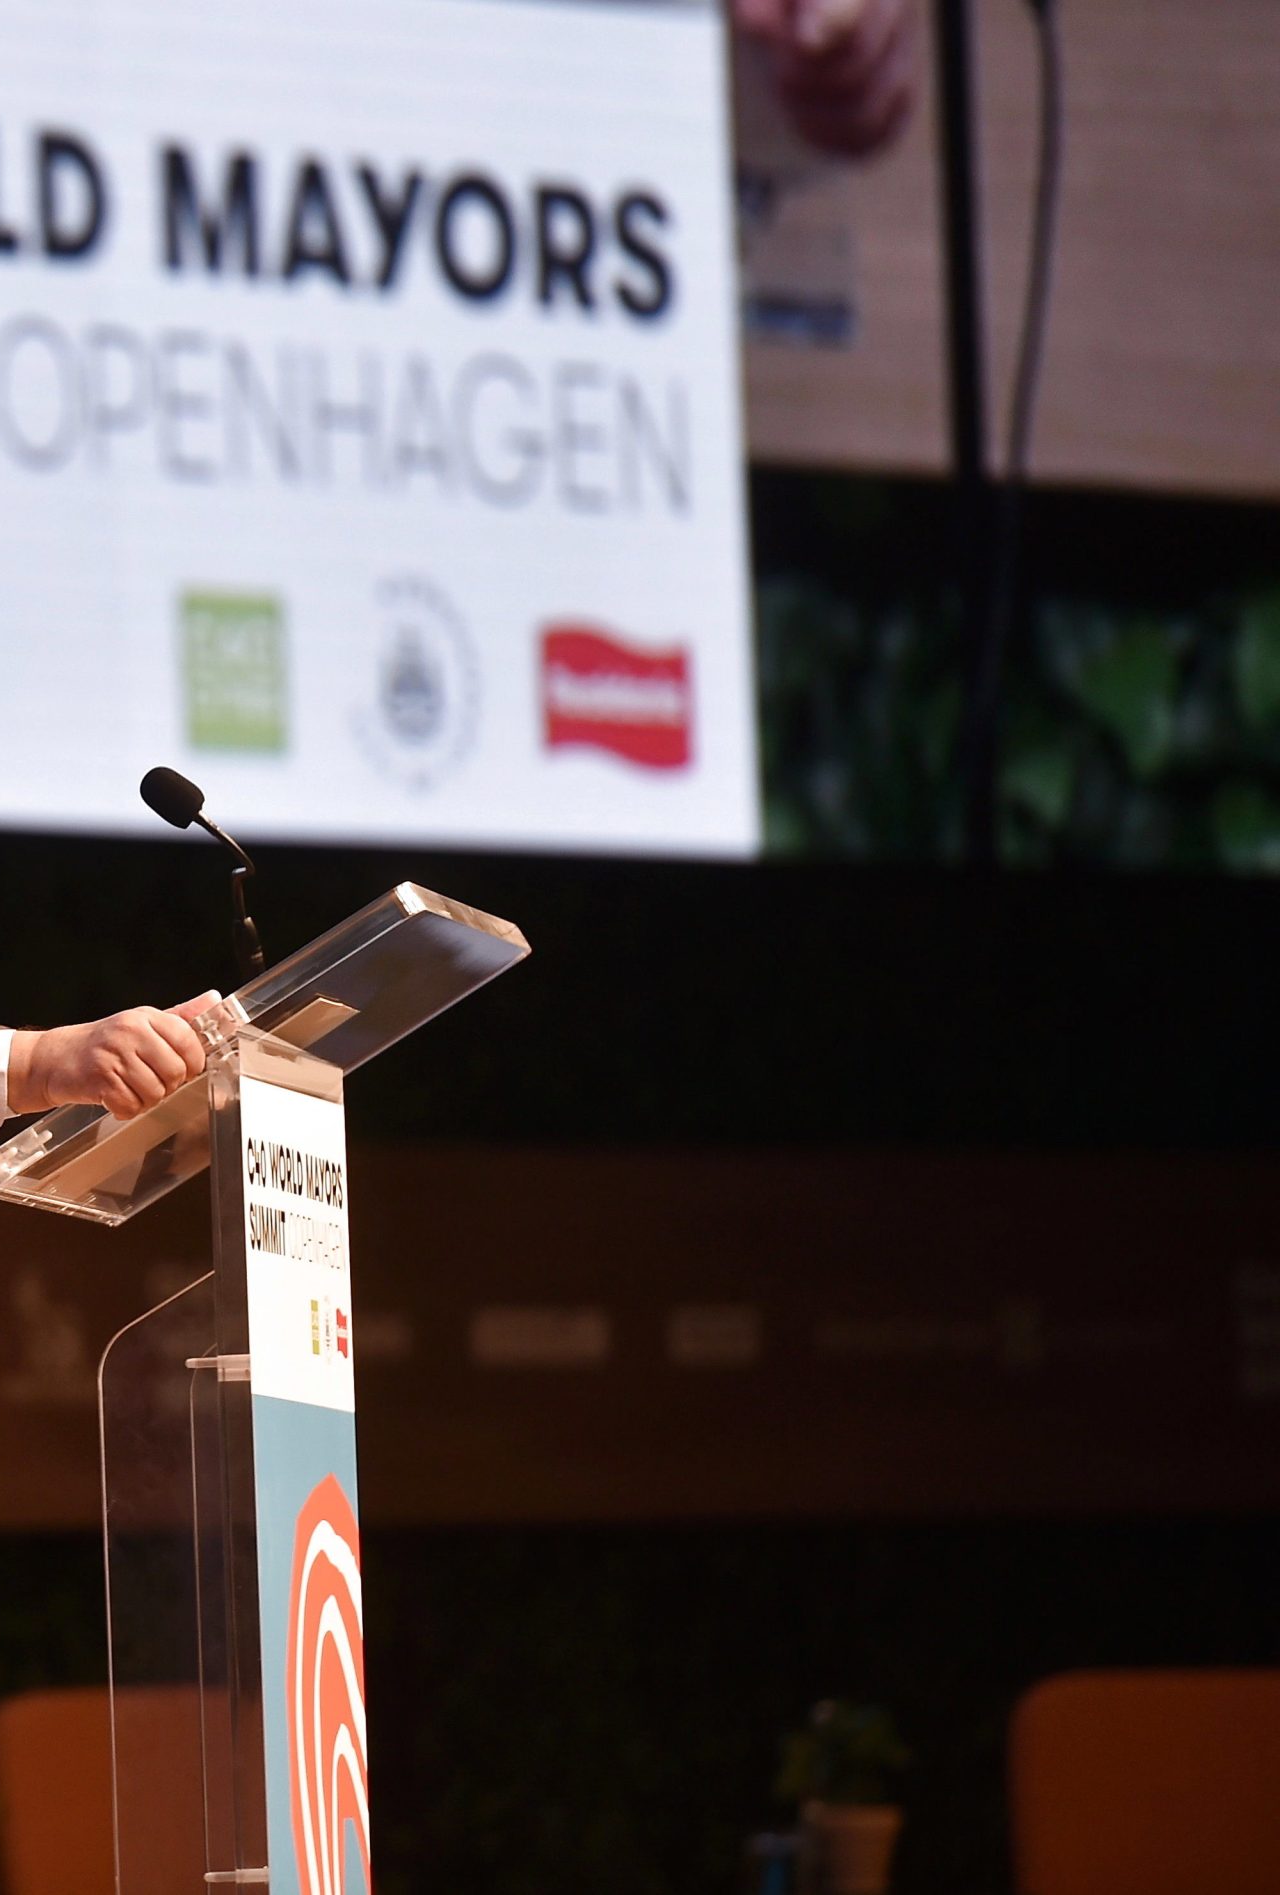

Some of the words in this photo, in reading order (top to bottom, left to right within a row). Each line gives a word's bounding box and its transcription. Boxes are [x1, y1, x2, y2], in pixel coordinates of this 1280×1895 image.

[161, 140, 674, 323] MAYORS
[247, 1136, 267, 1188] C40
[268, 1141, 303, 1197] WORLD
[305, 1153, 343, 1210] MAYORS
[249, 1202, 286, 1257] SUMMIT
